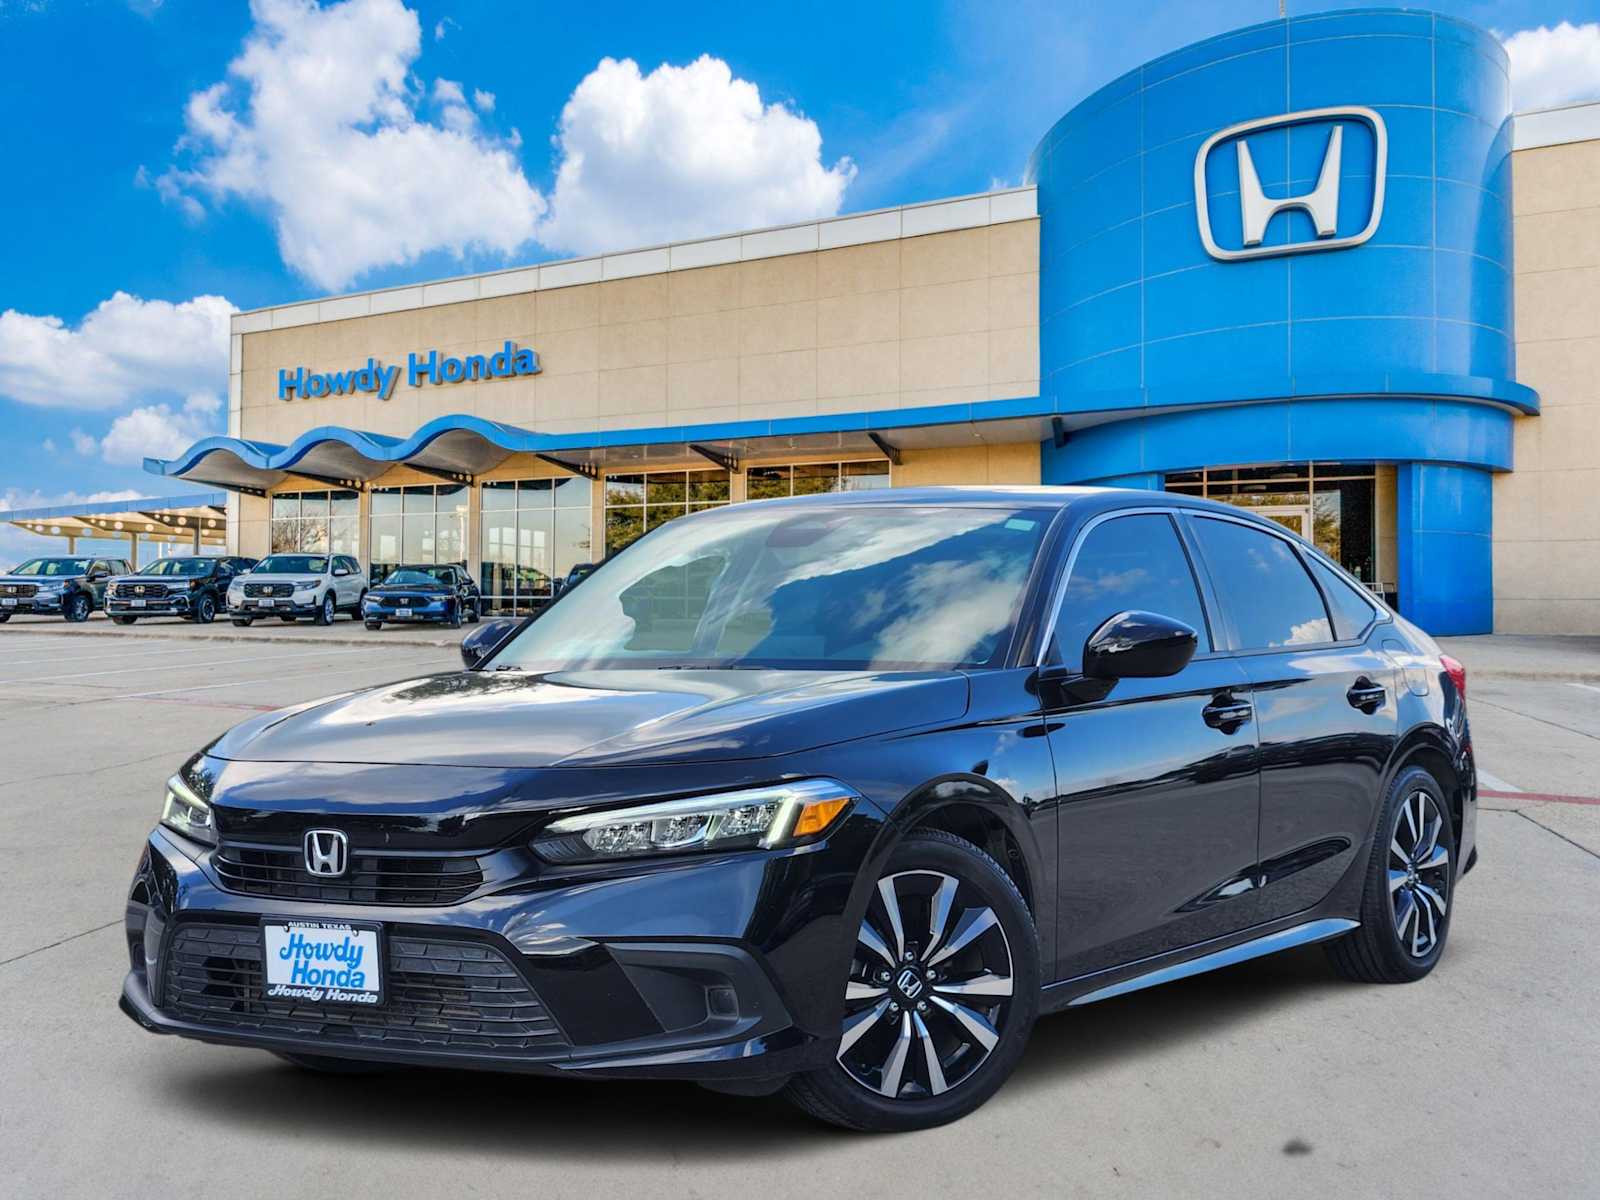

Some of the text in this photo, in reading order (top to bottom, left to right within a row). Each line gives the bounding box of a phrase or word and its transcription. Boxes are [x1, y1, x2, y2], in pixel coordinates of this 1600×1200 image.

[279, 340, 542, 401] Howdy Honda
[280, 933, 364, 969] Howdy
[290, 960, 366, 988] Honda
[267, 984, 378, 1003] Howdy Honda
